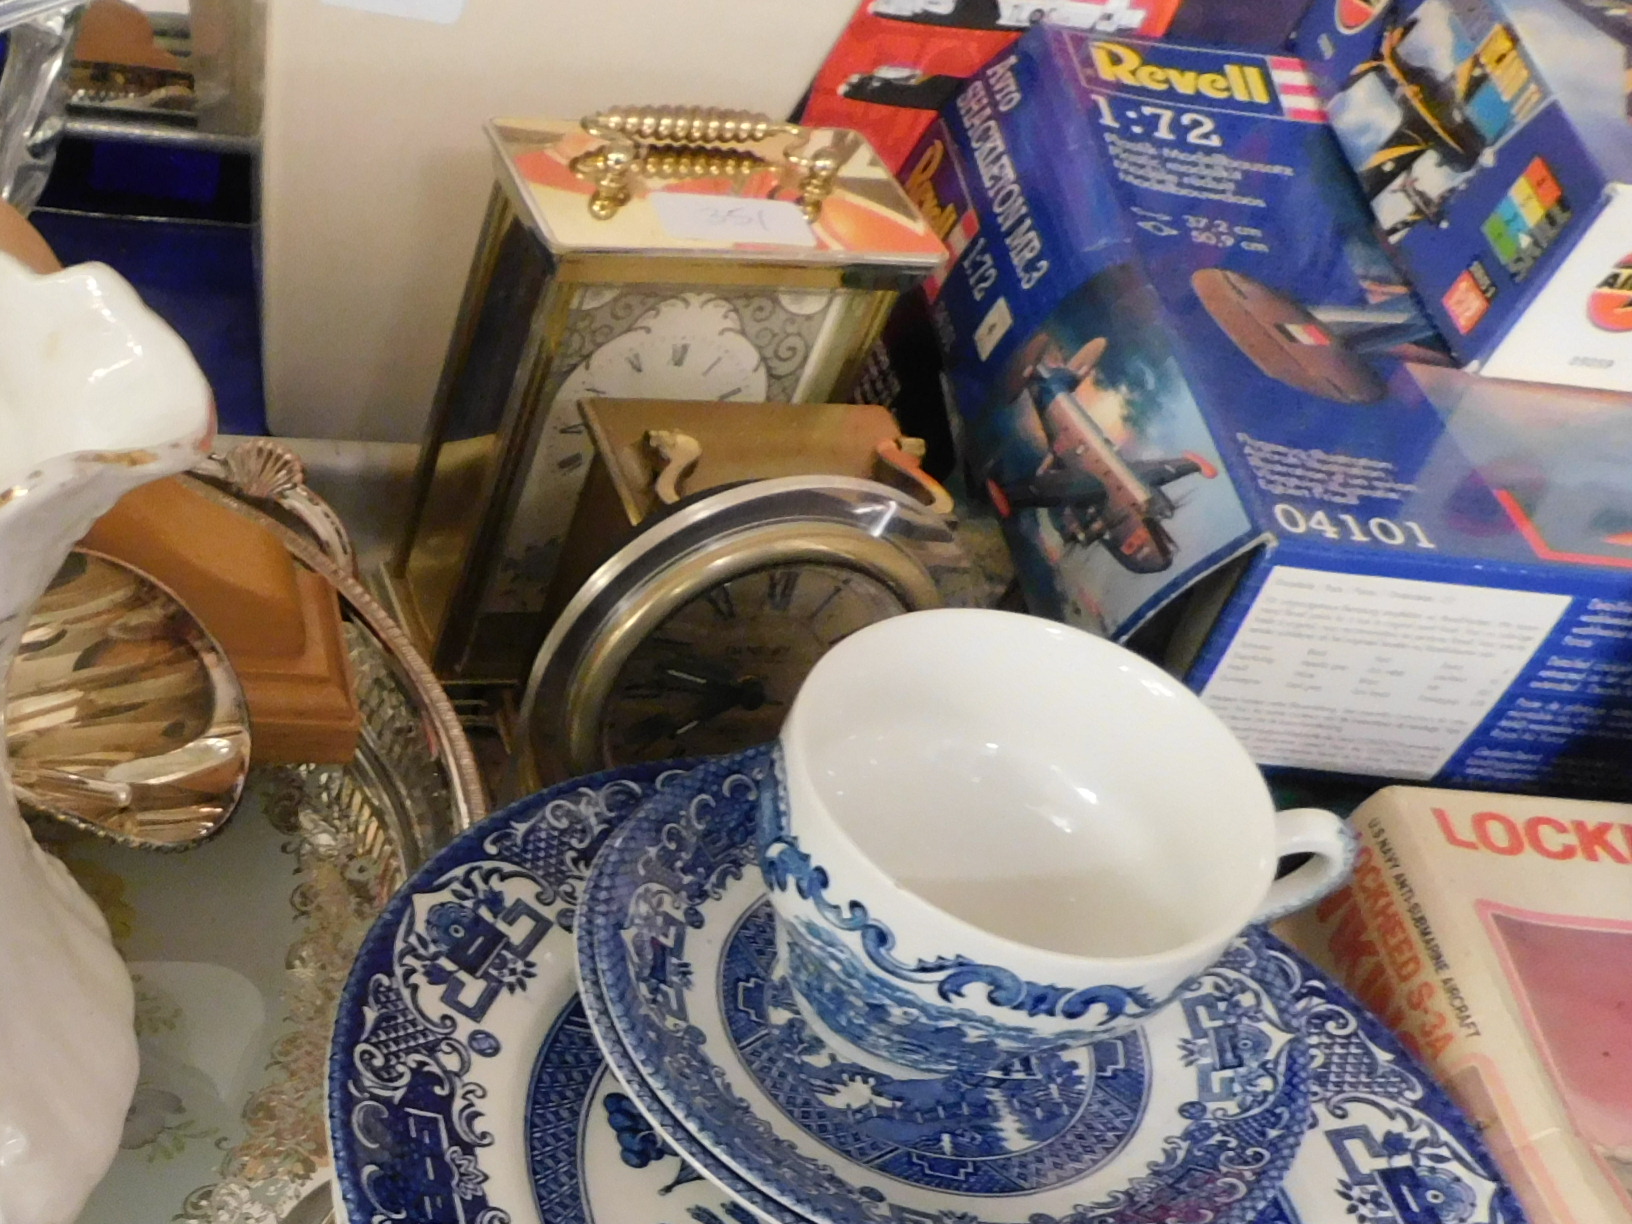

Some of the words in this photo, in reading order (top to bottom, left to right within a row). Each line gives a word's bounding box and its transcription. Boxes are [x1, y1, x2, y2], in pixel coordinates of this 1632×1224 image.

[1089, 40, 1271, 104] Revell
[1090, 93, 1223, 148] 1:72
[1273, 502, 1436, 549] 04101
[1431, 807, 1632, 865] LOCK
[1354, 830, 1425, 984] OCKHEED
[1441, 977, 1482, 1039] AIRCRAFT
